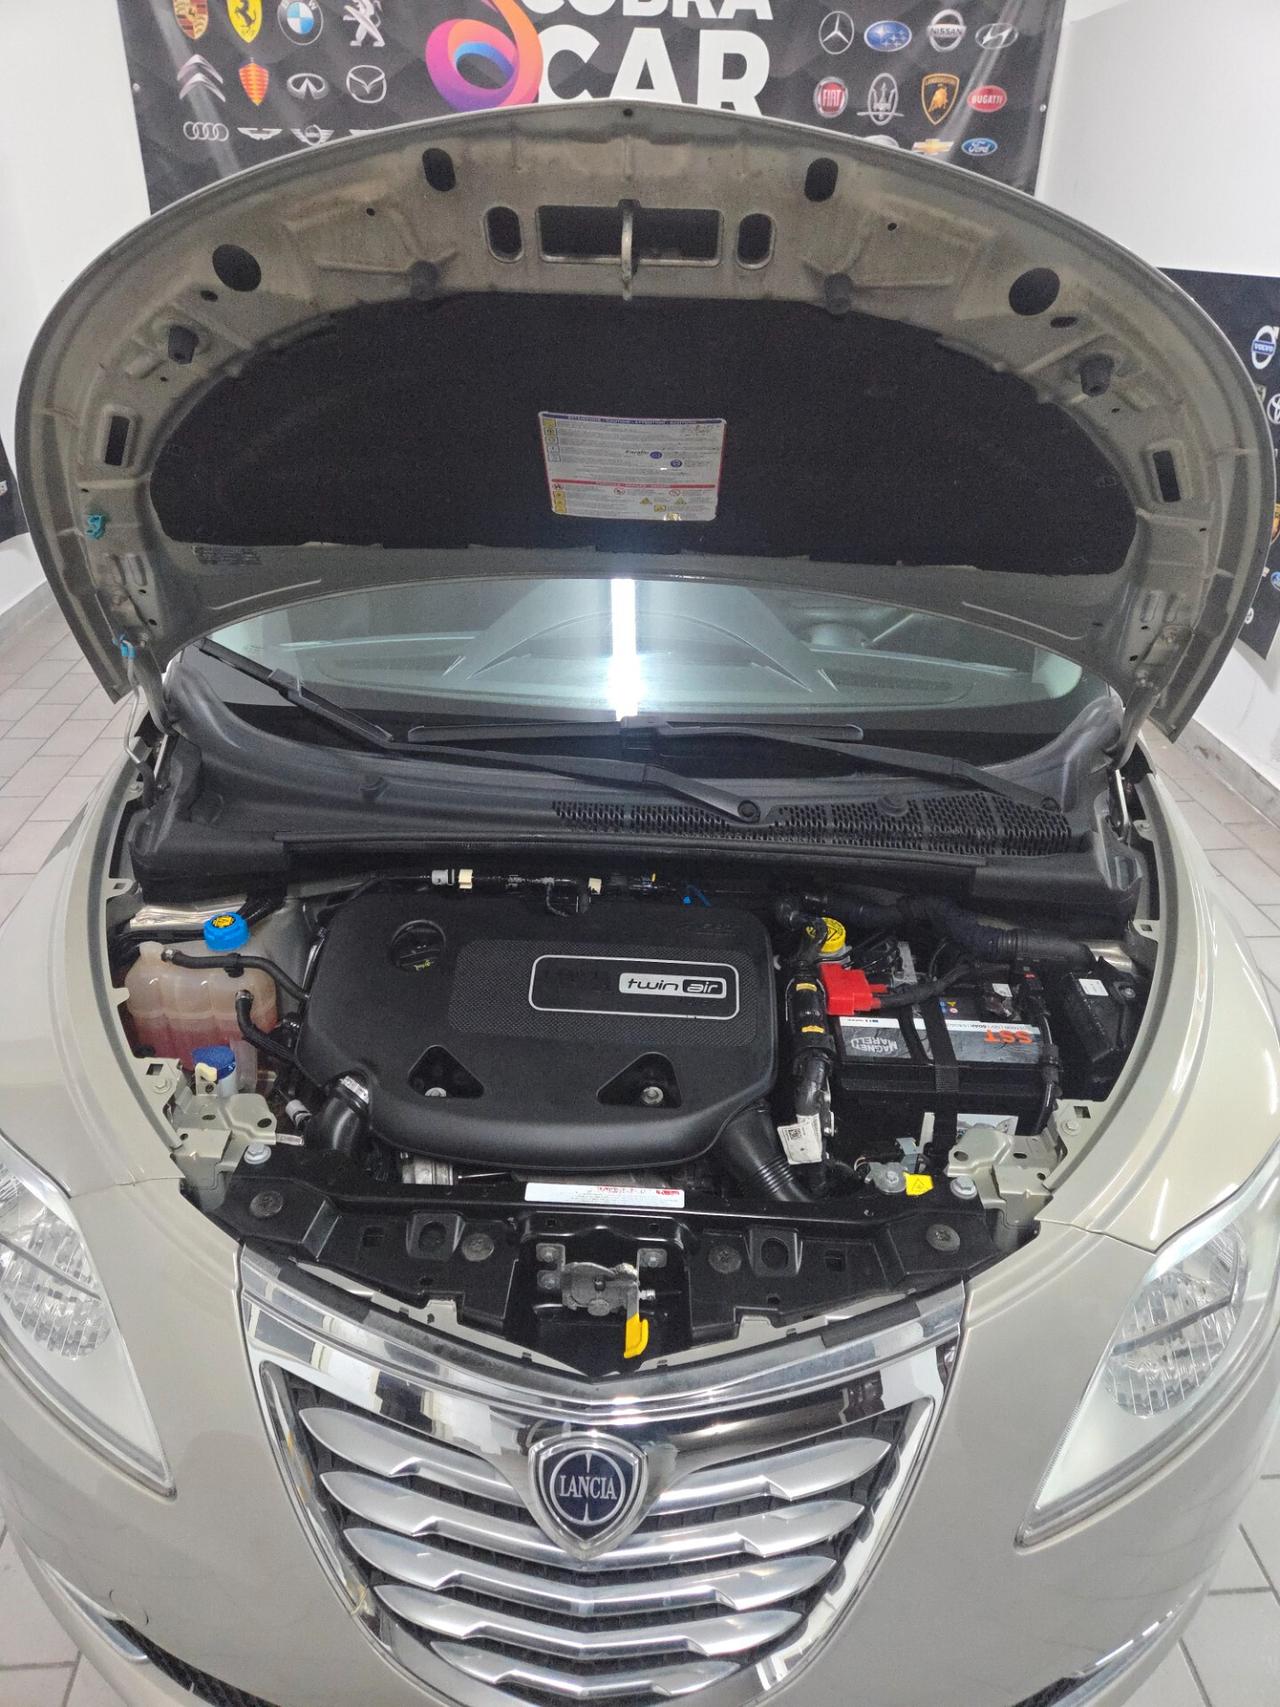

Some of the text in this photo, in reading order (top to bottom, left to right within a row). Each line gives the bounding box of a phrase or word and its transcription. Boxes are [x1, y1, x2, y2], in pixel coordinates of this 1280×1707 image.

[930, 27, 963, 36] NISSAN
[537, 24, 771, 117] CAR
[823, 89, 842, 107] FIAT
[971, 94, 1004, 105] BUGATTI
[968, 140, 992, 153] Ford
[628, 978, 718, 994] twin air
[984, 1028, 1033, 1045] SST
[559, 1475, 618, 1500] LANCIA
